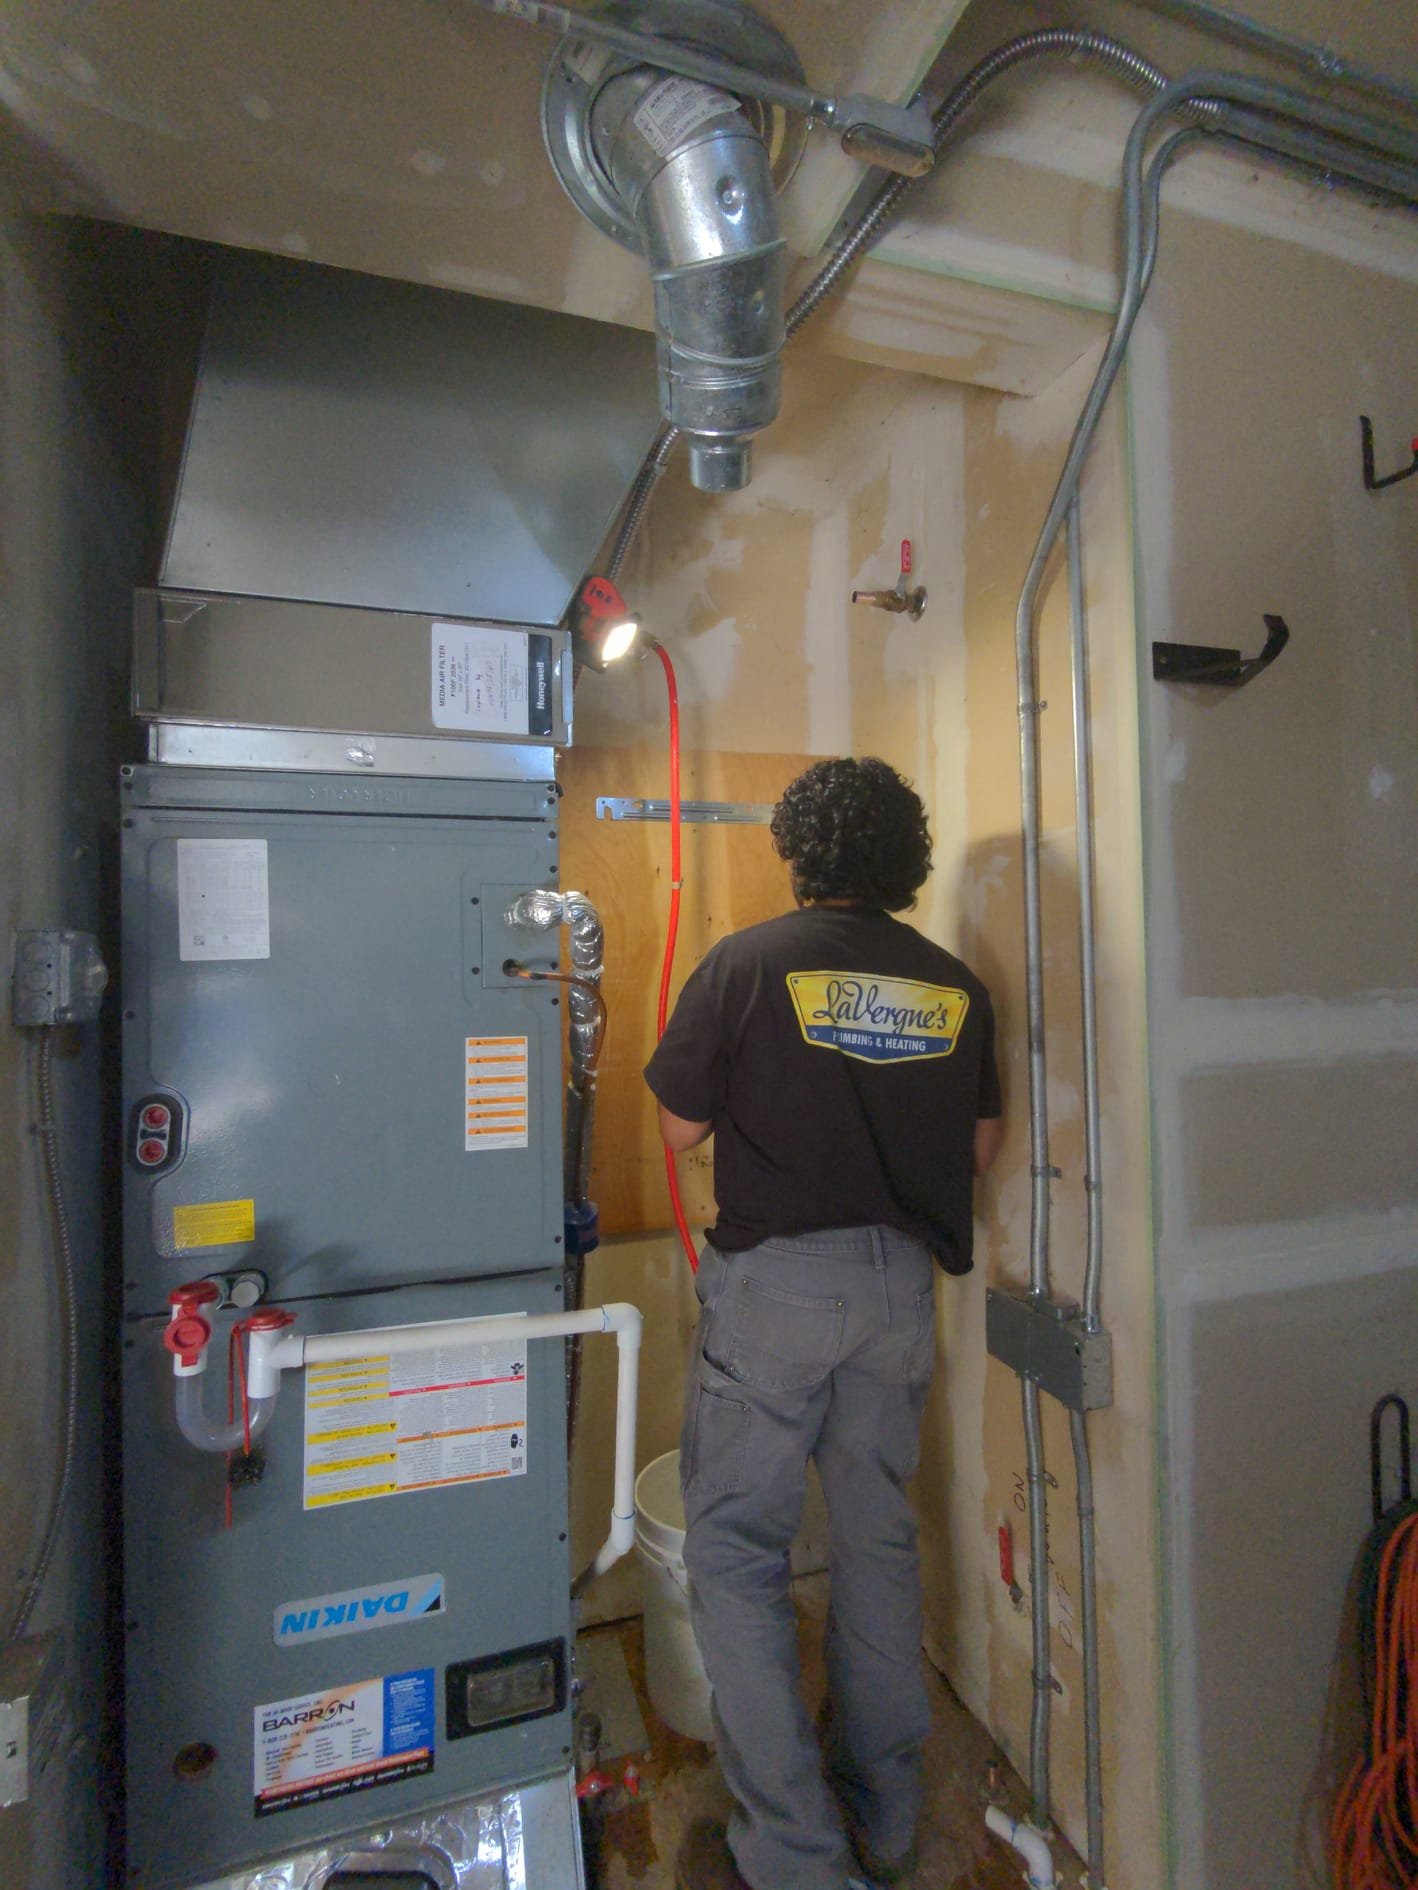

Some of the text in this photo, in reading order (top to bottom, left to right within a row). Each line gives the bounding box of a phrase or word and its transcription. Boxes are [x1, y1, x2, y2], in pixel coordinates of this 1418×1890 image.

[536, 661, 546, 709] Honeywell
[813, 980, 947, 1034] LaVergne's
[875, 1036, 883, 1048] &
[885, 1037, 927, 1052] HEATING
[280, 1591, 409, 1635] DAIKIN
[262, 1699, 355, 1733] BARRON
